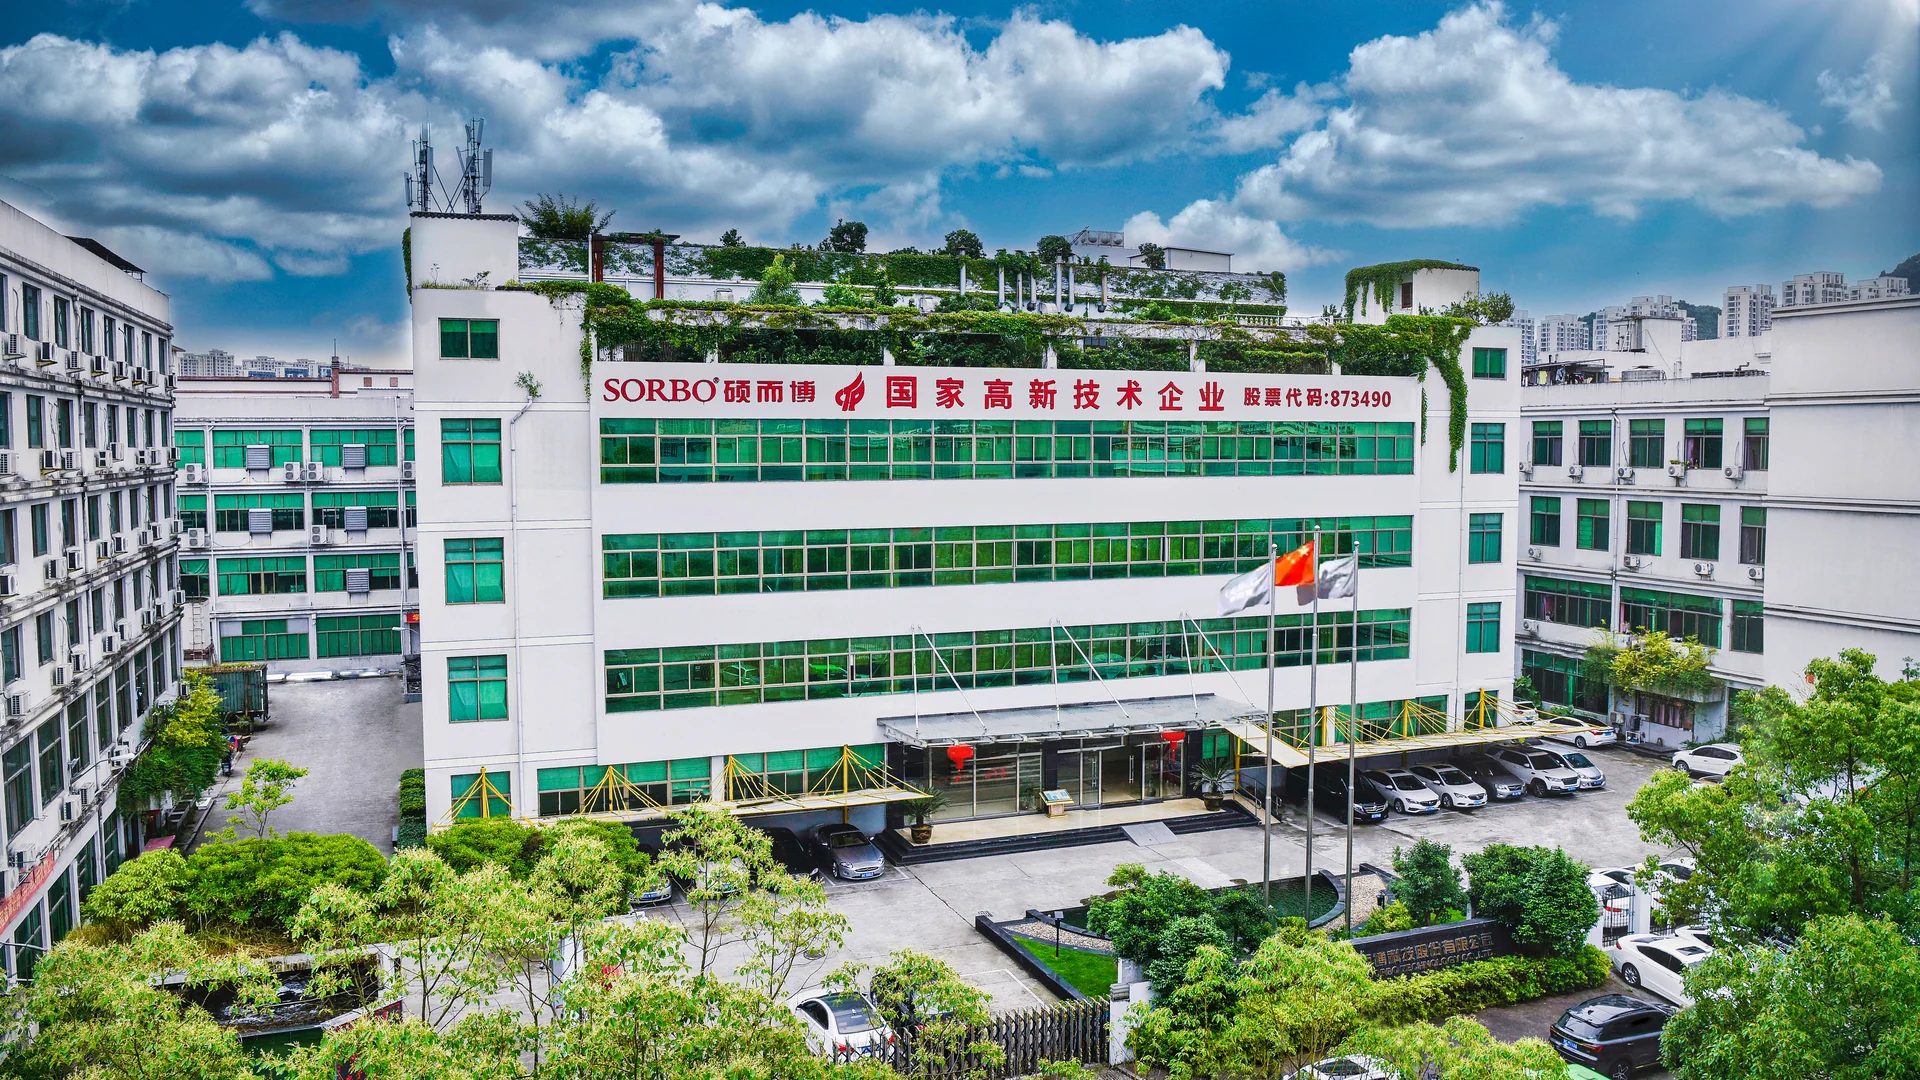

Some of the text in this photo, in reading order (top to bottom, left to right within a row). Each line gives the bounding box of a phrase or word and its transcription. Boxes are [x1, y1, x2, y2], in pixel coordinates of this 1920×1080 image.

[724, 379, 816, 403] 硕而博
[885, 375, 1224, 410] 国家高新技术企业
